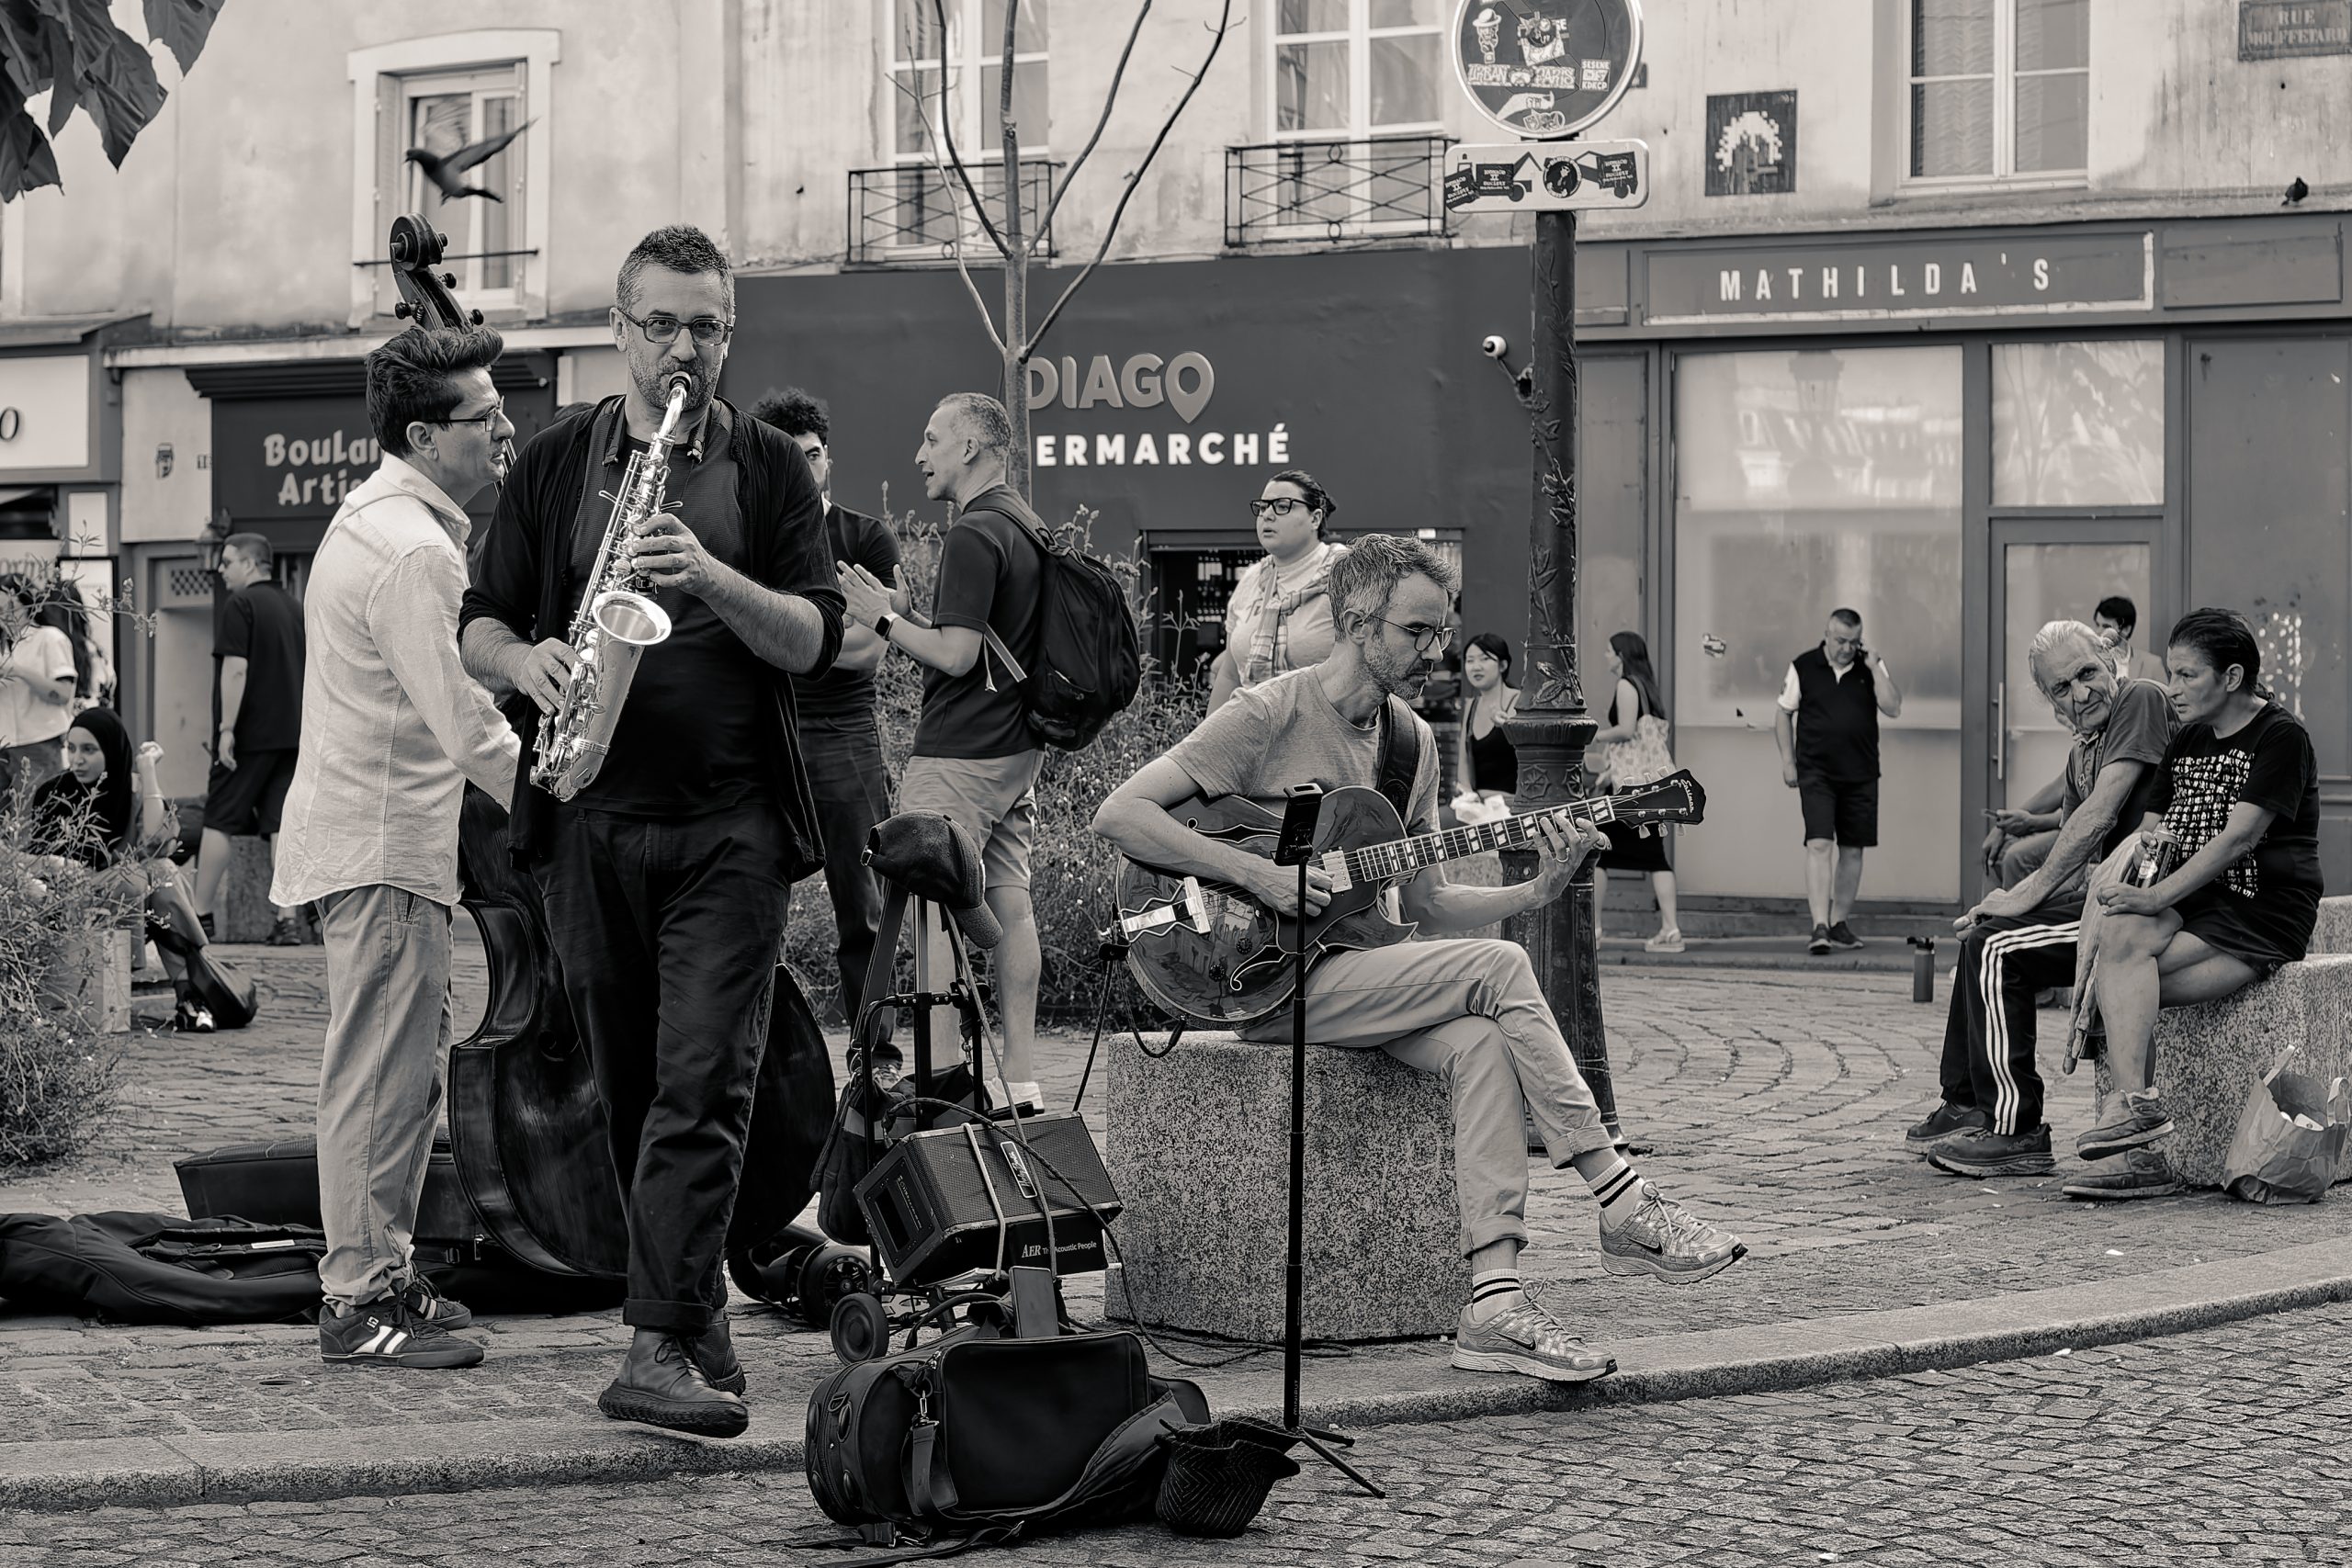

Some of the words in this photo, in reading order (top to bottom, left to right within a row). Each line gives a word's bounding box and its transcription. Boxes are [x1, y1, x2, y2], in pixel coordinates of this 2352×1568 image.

[2278, 9, 2315, 25] RUE
[1535, 67, 1575, 87] PARIS
[1720, 252, 2050, 301] MATHILDA'S
[1028, 351, 1216, 424] DIAGO
[1021, 1244, 1041, 1258] AER
[1077, 1240, 1097, 1250] People
